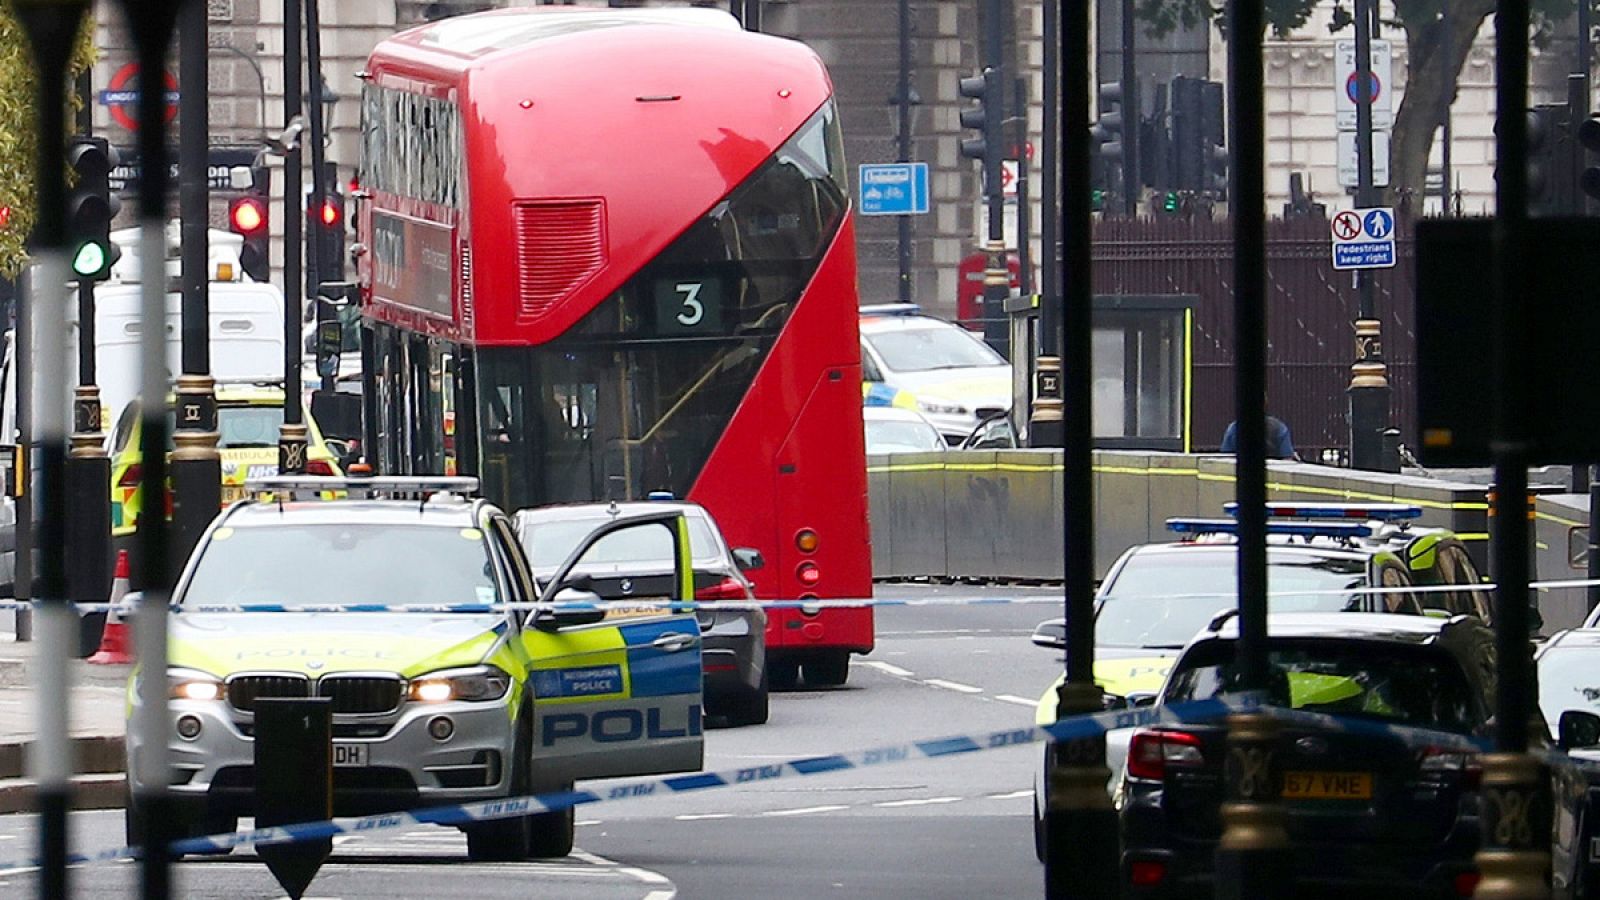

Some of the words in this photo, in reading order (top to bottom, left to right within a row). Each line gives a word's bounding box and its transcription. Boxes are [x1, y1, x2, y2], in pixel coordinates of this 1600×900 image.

[1336, 244, 1390, 254] Pedestrians
[1340, 255, 1363, 264] keep
[1366, 253, 1388, 263] right
[676, 283, 703, 325] 3
[572, 680, 611, 691] POLICE
[302, 715, 309, 729] 1
[541, 704, 701, 747] POLI
